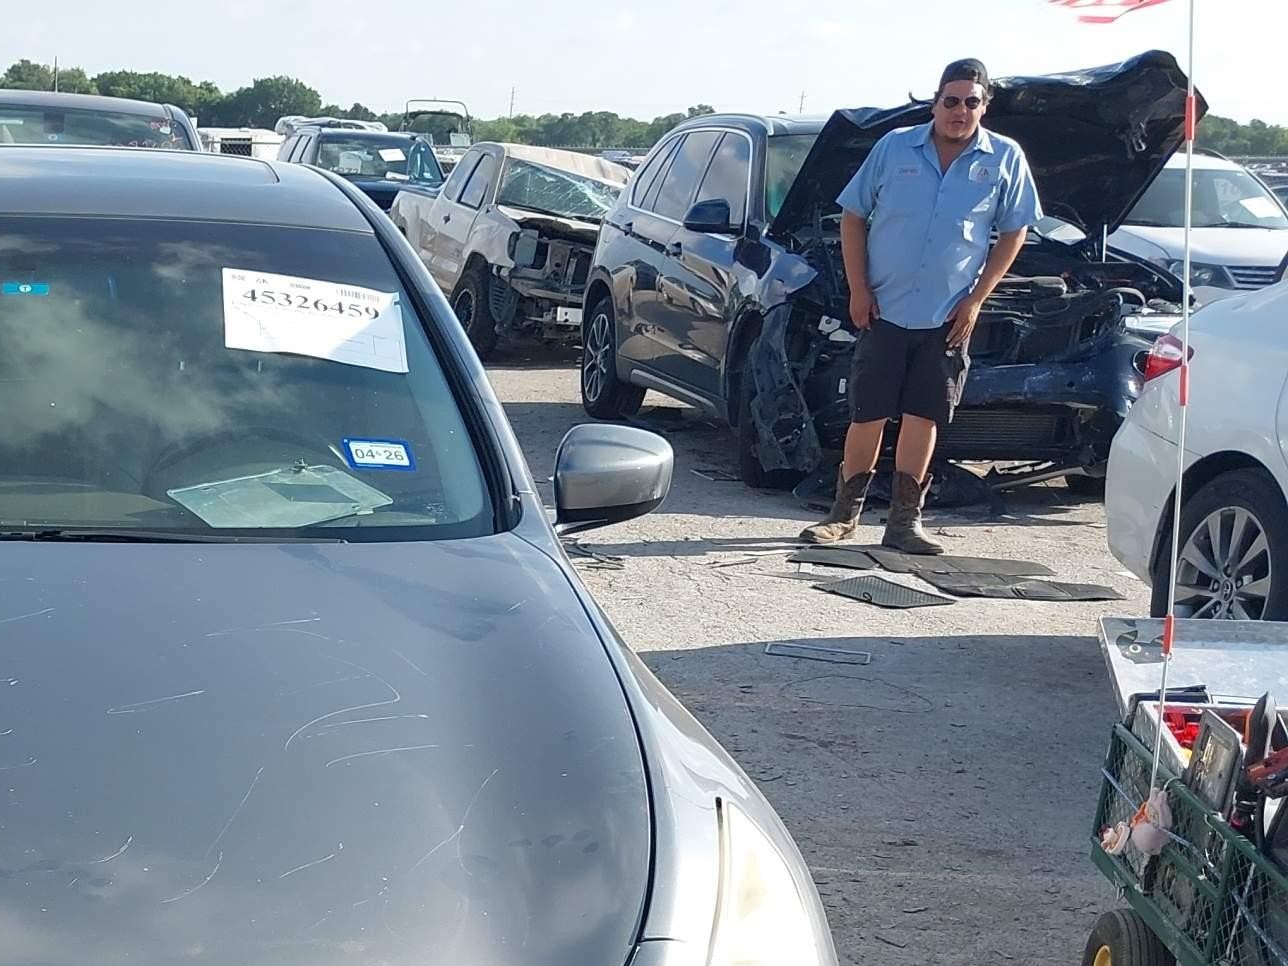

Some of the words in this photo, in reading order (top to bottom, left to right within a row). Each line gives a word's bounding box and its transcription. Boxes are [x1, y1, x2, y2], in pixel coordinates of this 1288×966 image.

[242, 289, 380, 320] 45326459
[354, 448, 376, 460] 04
[383, 449, 405, 461] 26
